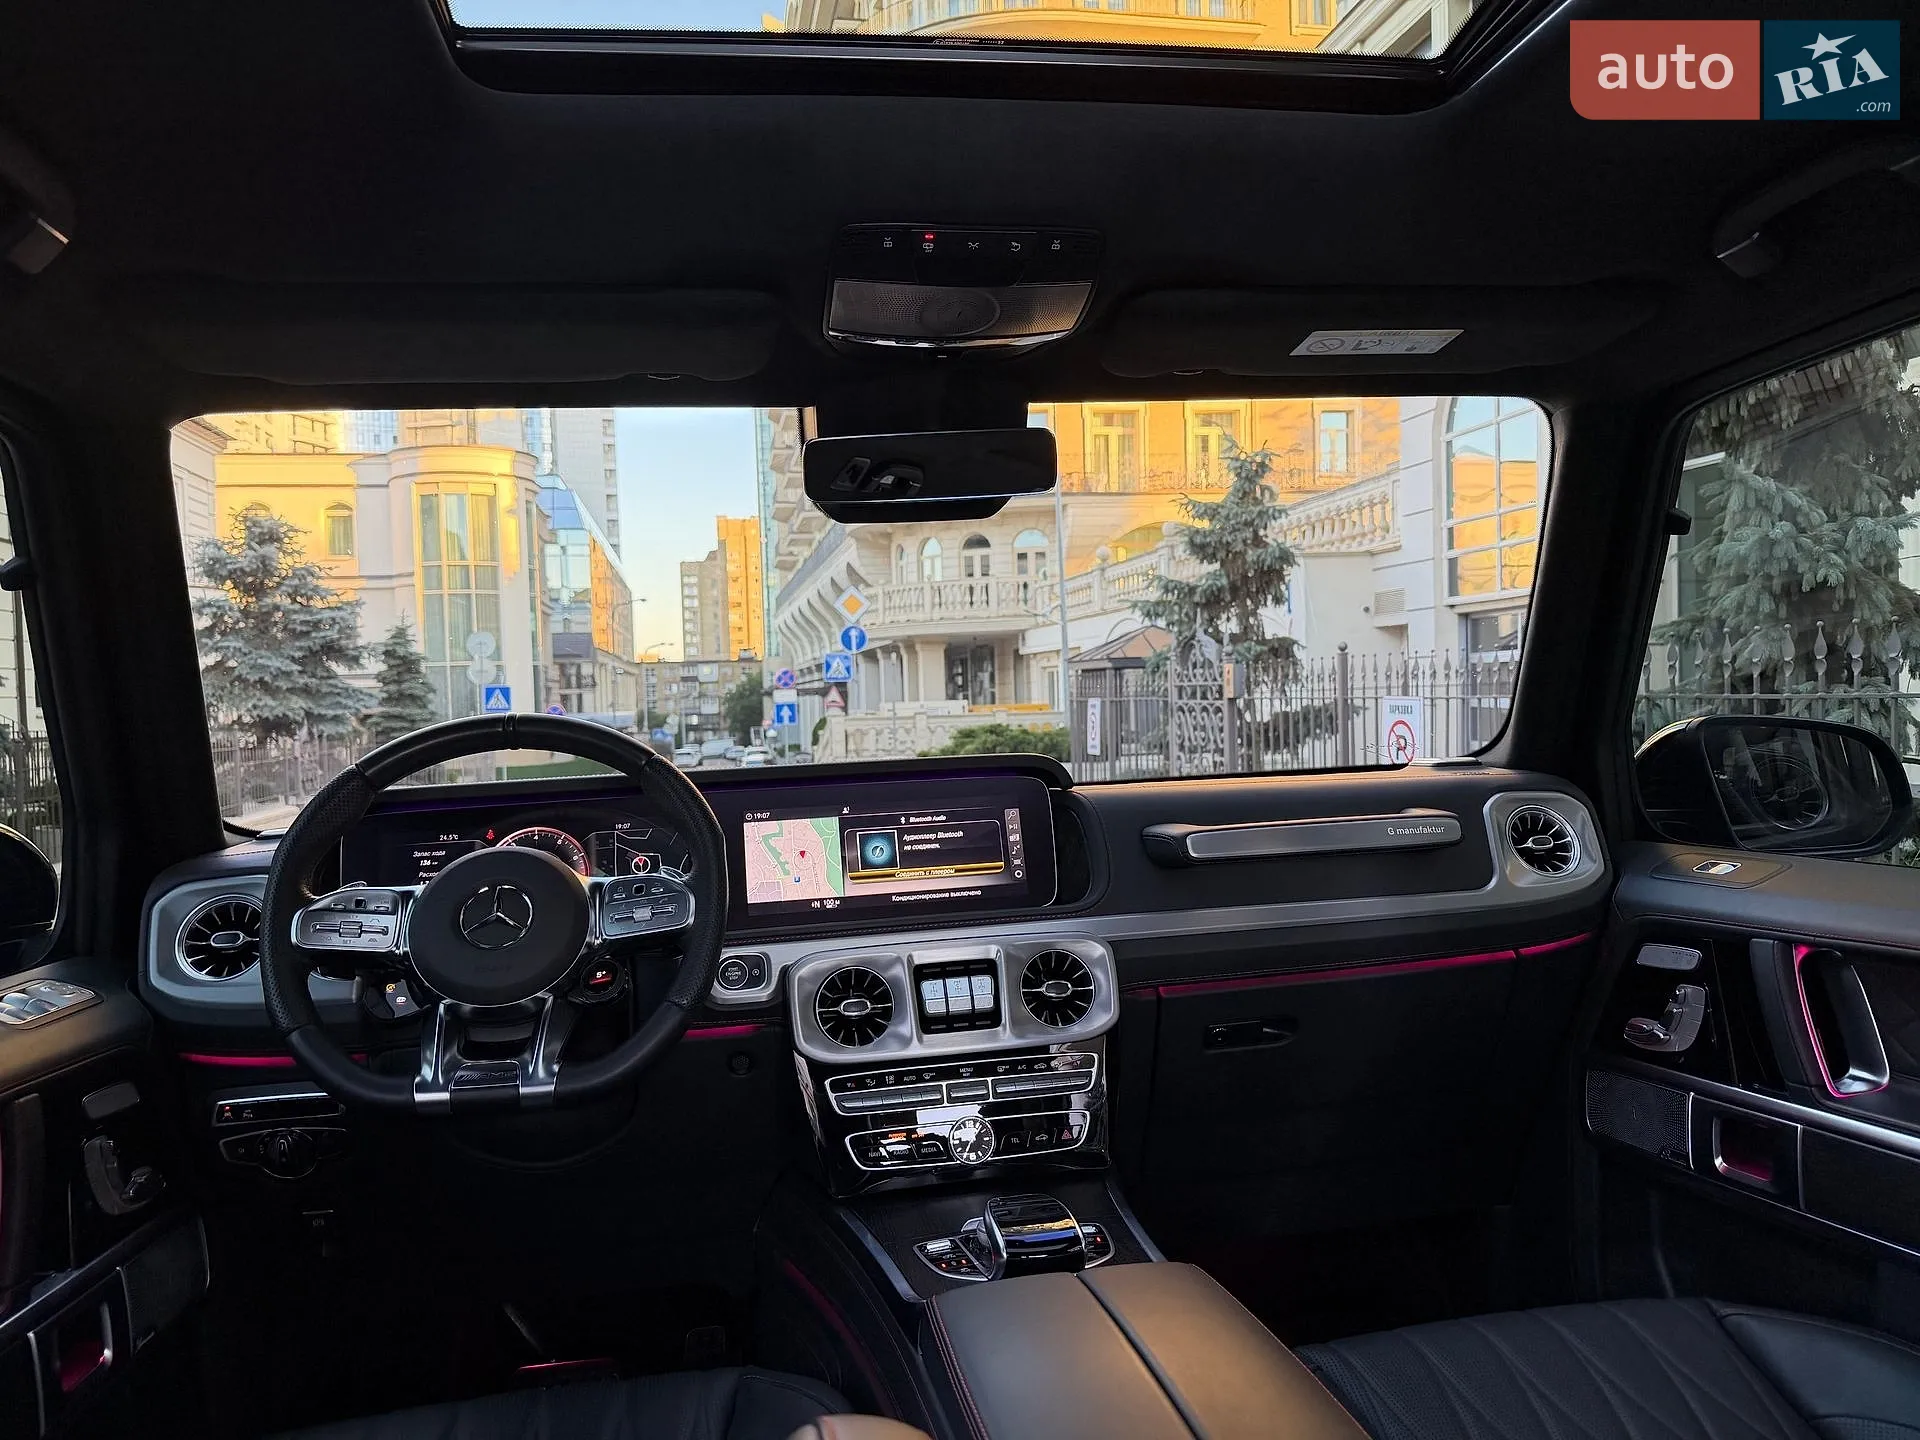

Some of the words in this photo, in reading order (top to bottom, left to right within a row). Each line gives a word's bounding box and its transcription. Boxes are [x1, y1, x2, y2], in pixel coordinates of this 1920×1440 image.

[753, 812, 770, 820] 19:07
[933, 814, 947, 822] Audio
[615, 822, 631, 830] 19:07
[1387, 827, 1395, 835] G
[1396, 825, 1445, 835] manufaktur
[902, 832, 937, 842] Аудиоплеер
[937, 830, 964, 839] Bluetooth
[412, 850, 432, 858] Запас
[895, 870, 925, 878] Соединить
[930, 867, 956, 876] плеером
[891, 892, 950, 902] Кондиционирование
[950, 890, 982, 899] выключено
[814, 900, 821, 909] N
[823, 898, 834, 906] 100
[965, 1120, 974, 1128] 12
[969, 1152, 977, 1160] 6
